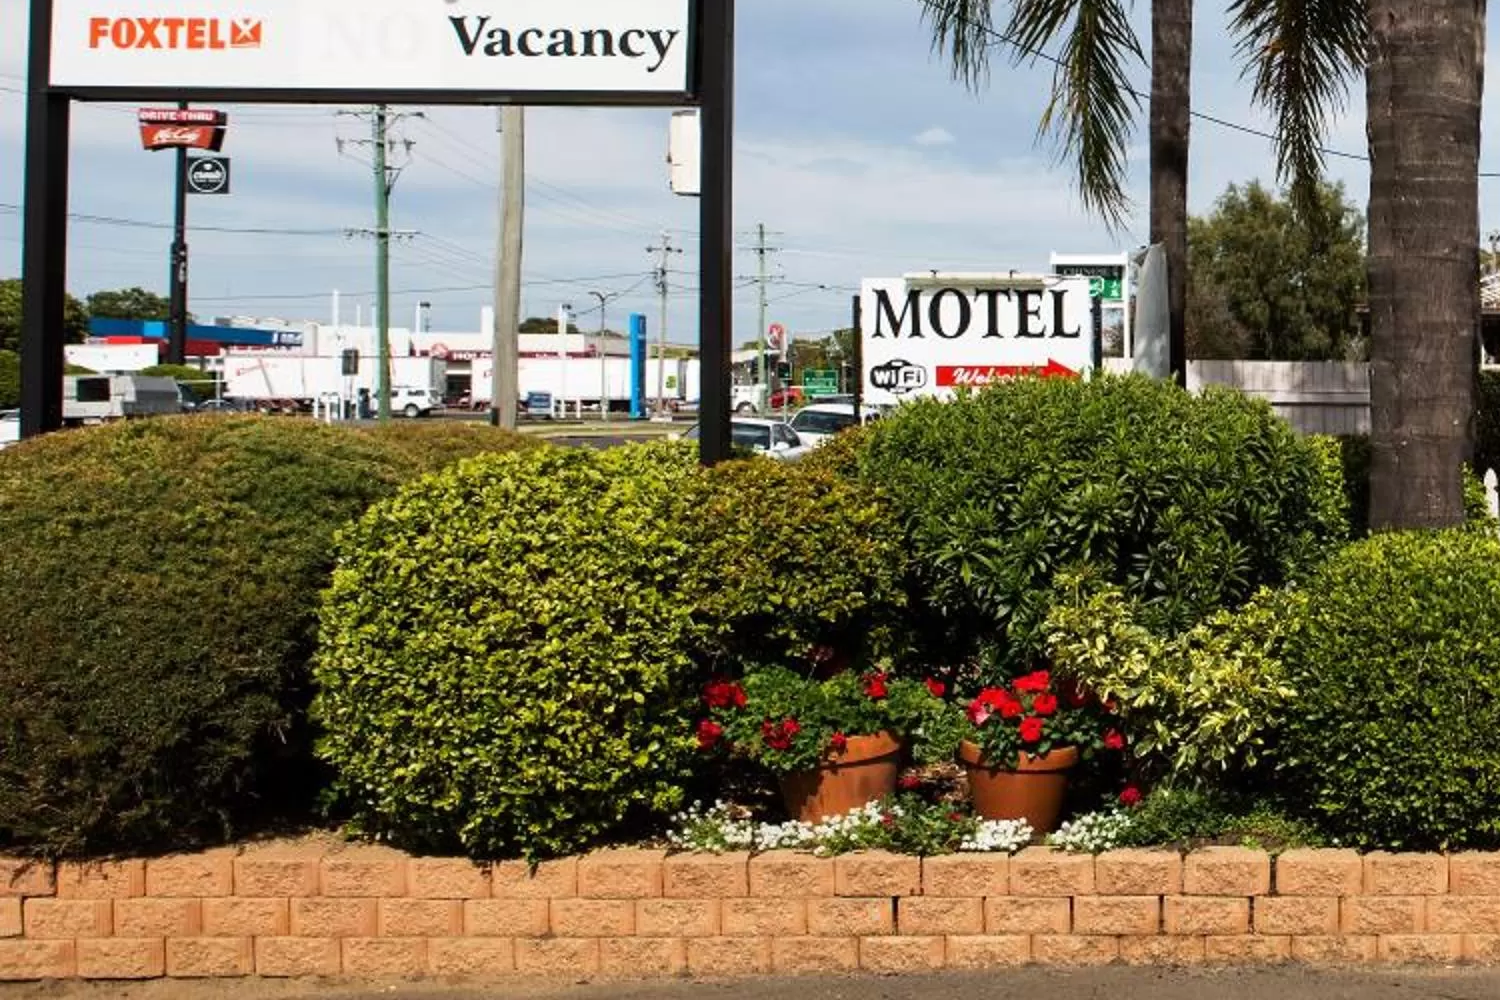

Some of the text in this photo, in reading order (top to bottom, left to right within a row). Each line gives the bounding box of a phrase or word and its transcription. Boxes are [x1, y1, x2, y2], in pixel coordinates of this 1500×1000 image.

[88, 16, 225, 50] FOXTEL
[447, 14, 680, 72] Vacancy
[872, 288, 1081, 339] MOTEL
